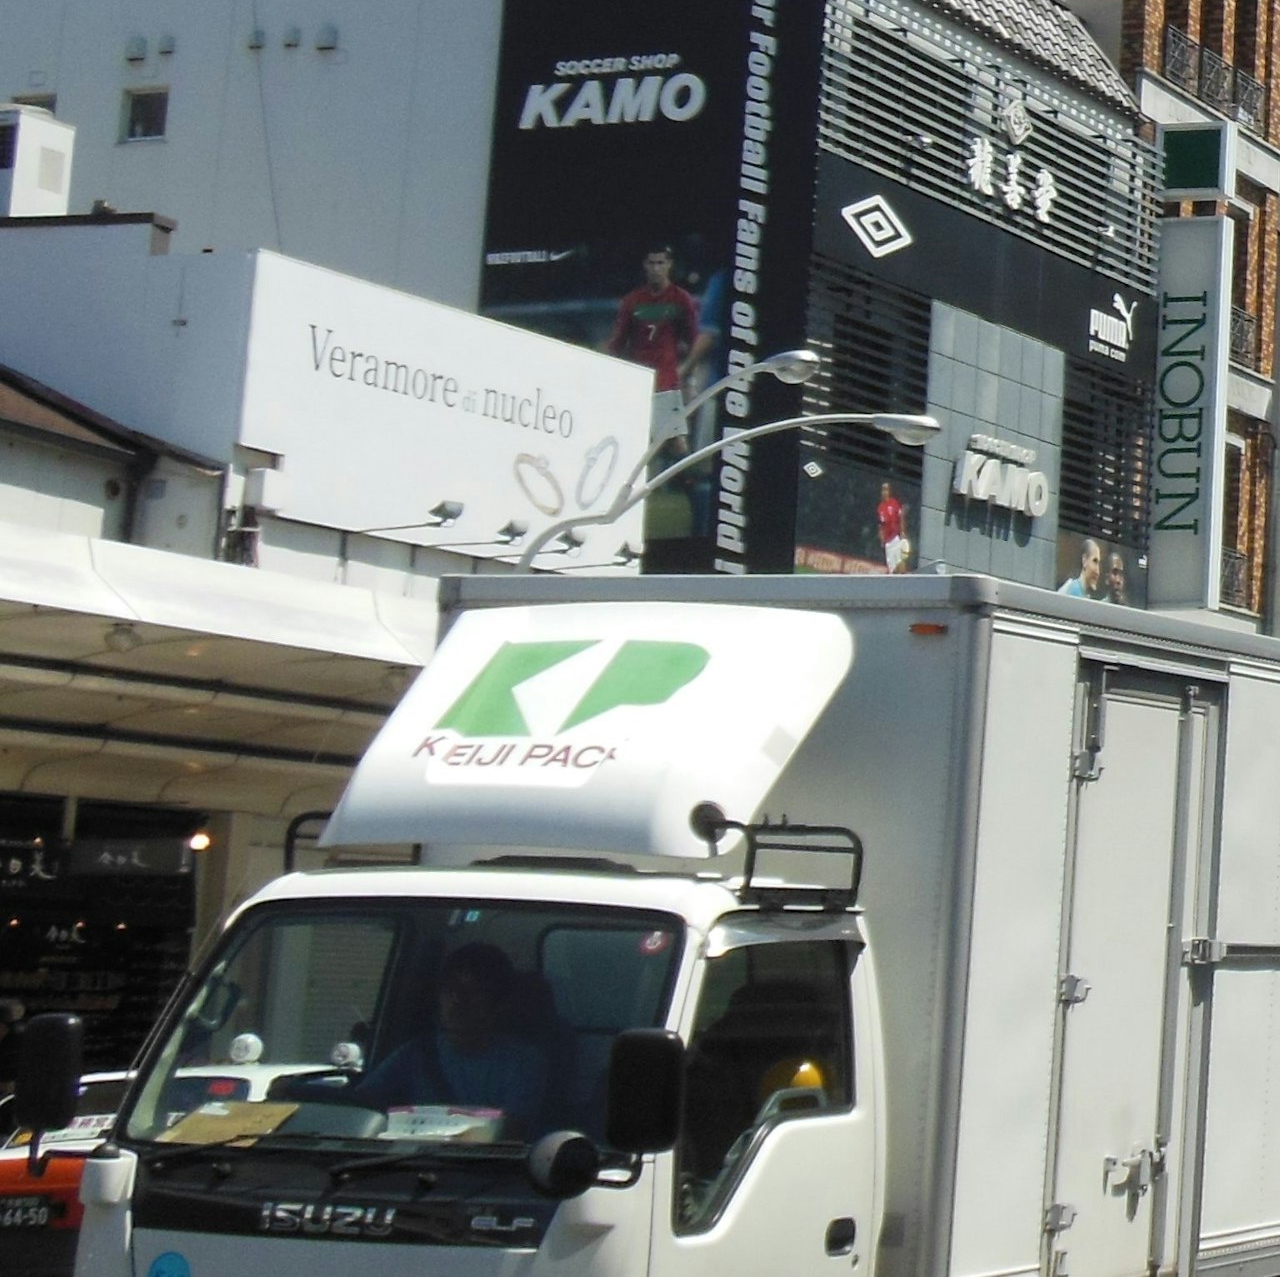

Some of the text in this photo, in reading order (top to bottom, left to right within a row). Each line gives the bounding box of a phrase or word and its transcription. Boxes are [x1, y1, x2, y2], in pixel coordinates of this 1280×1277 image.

[518, 72, 706, 130] KAMO
[554, 52, 682, 77] SOCCER SHOP
[740, 30, 777, 195] Football
[732, 198, 766, 296] Fans
[308, 323, 459, 408] Veramore
[482, 387, 574, 440] nucleo
[1153, 290, 1207, 536] INOBUN
[715, 426, 752, 554] World
[954, 450, 1050, 518] KAMO
[411, 736, 517, 767] KEIJI
[260, 1201, 397, 1236] ISUZU
